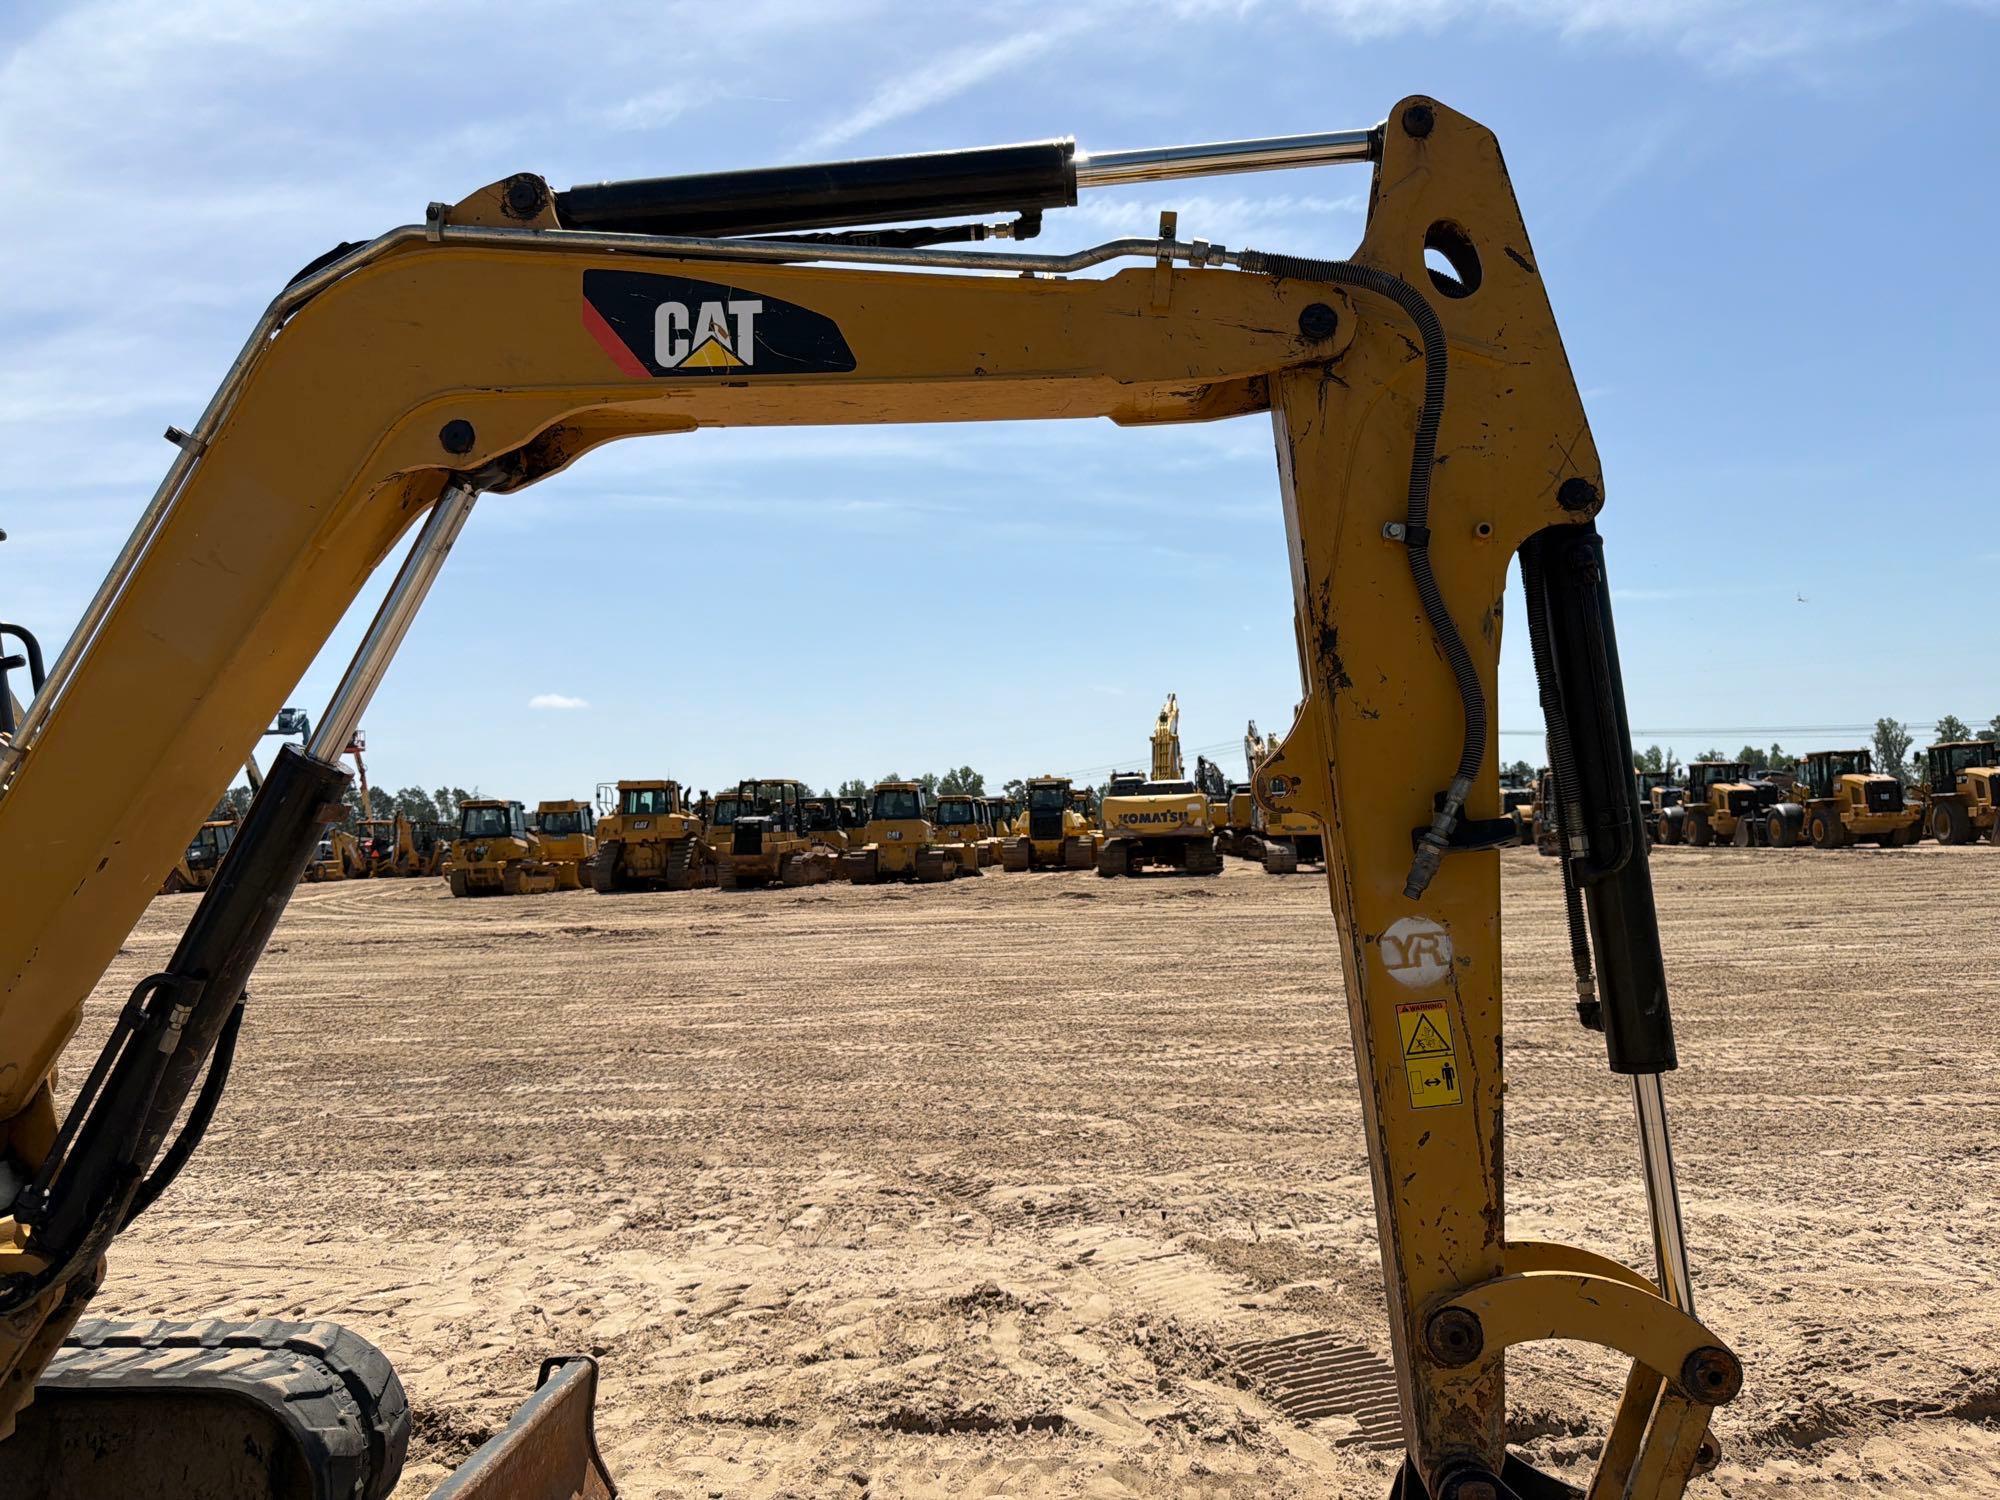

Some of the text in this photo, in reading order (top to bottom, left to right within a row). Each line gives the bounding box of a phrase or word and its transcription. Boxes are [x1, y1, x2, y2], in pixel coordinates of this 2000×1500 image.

[655, 300, 762, 368] CAT
[1118, 809, 1188, 824] KOMATSU
[634, 821, 649, 829] CAT
[1409, 1002, 1443, 1012] WARNING
